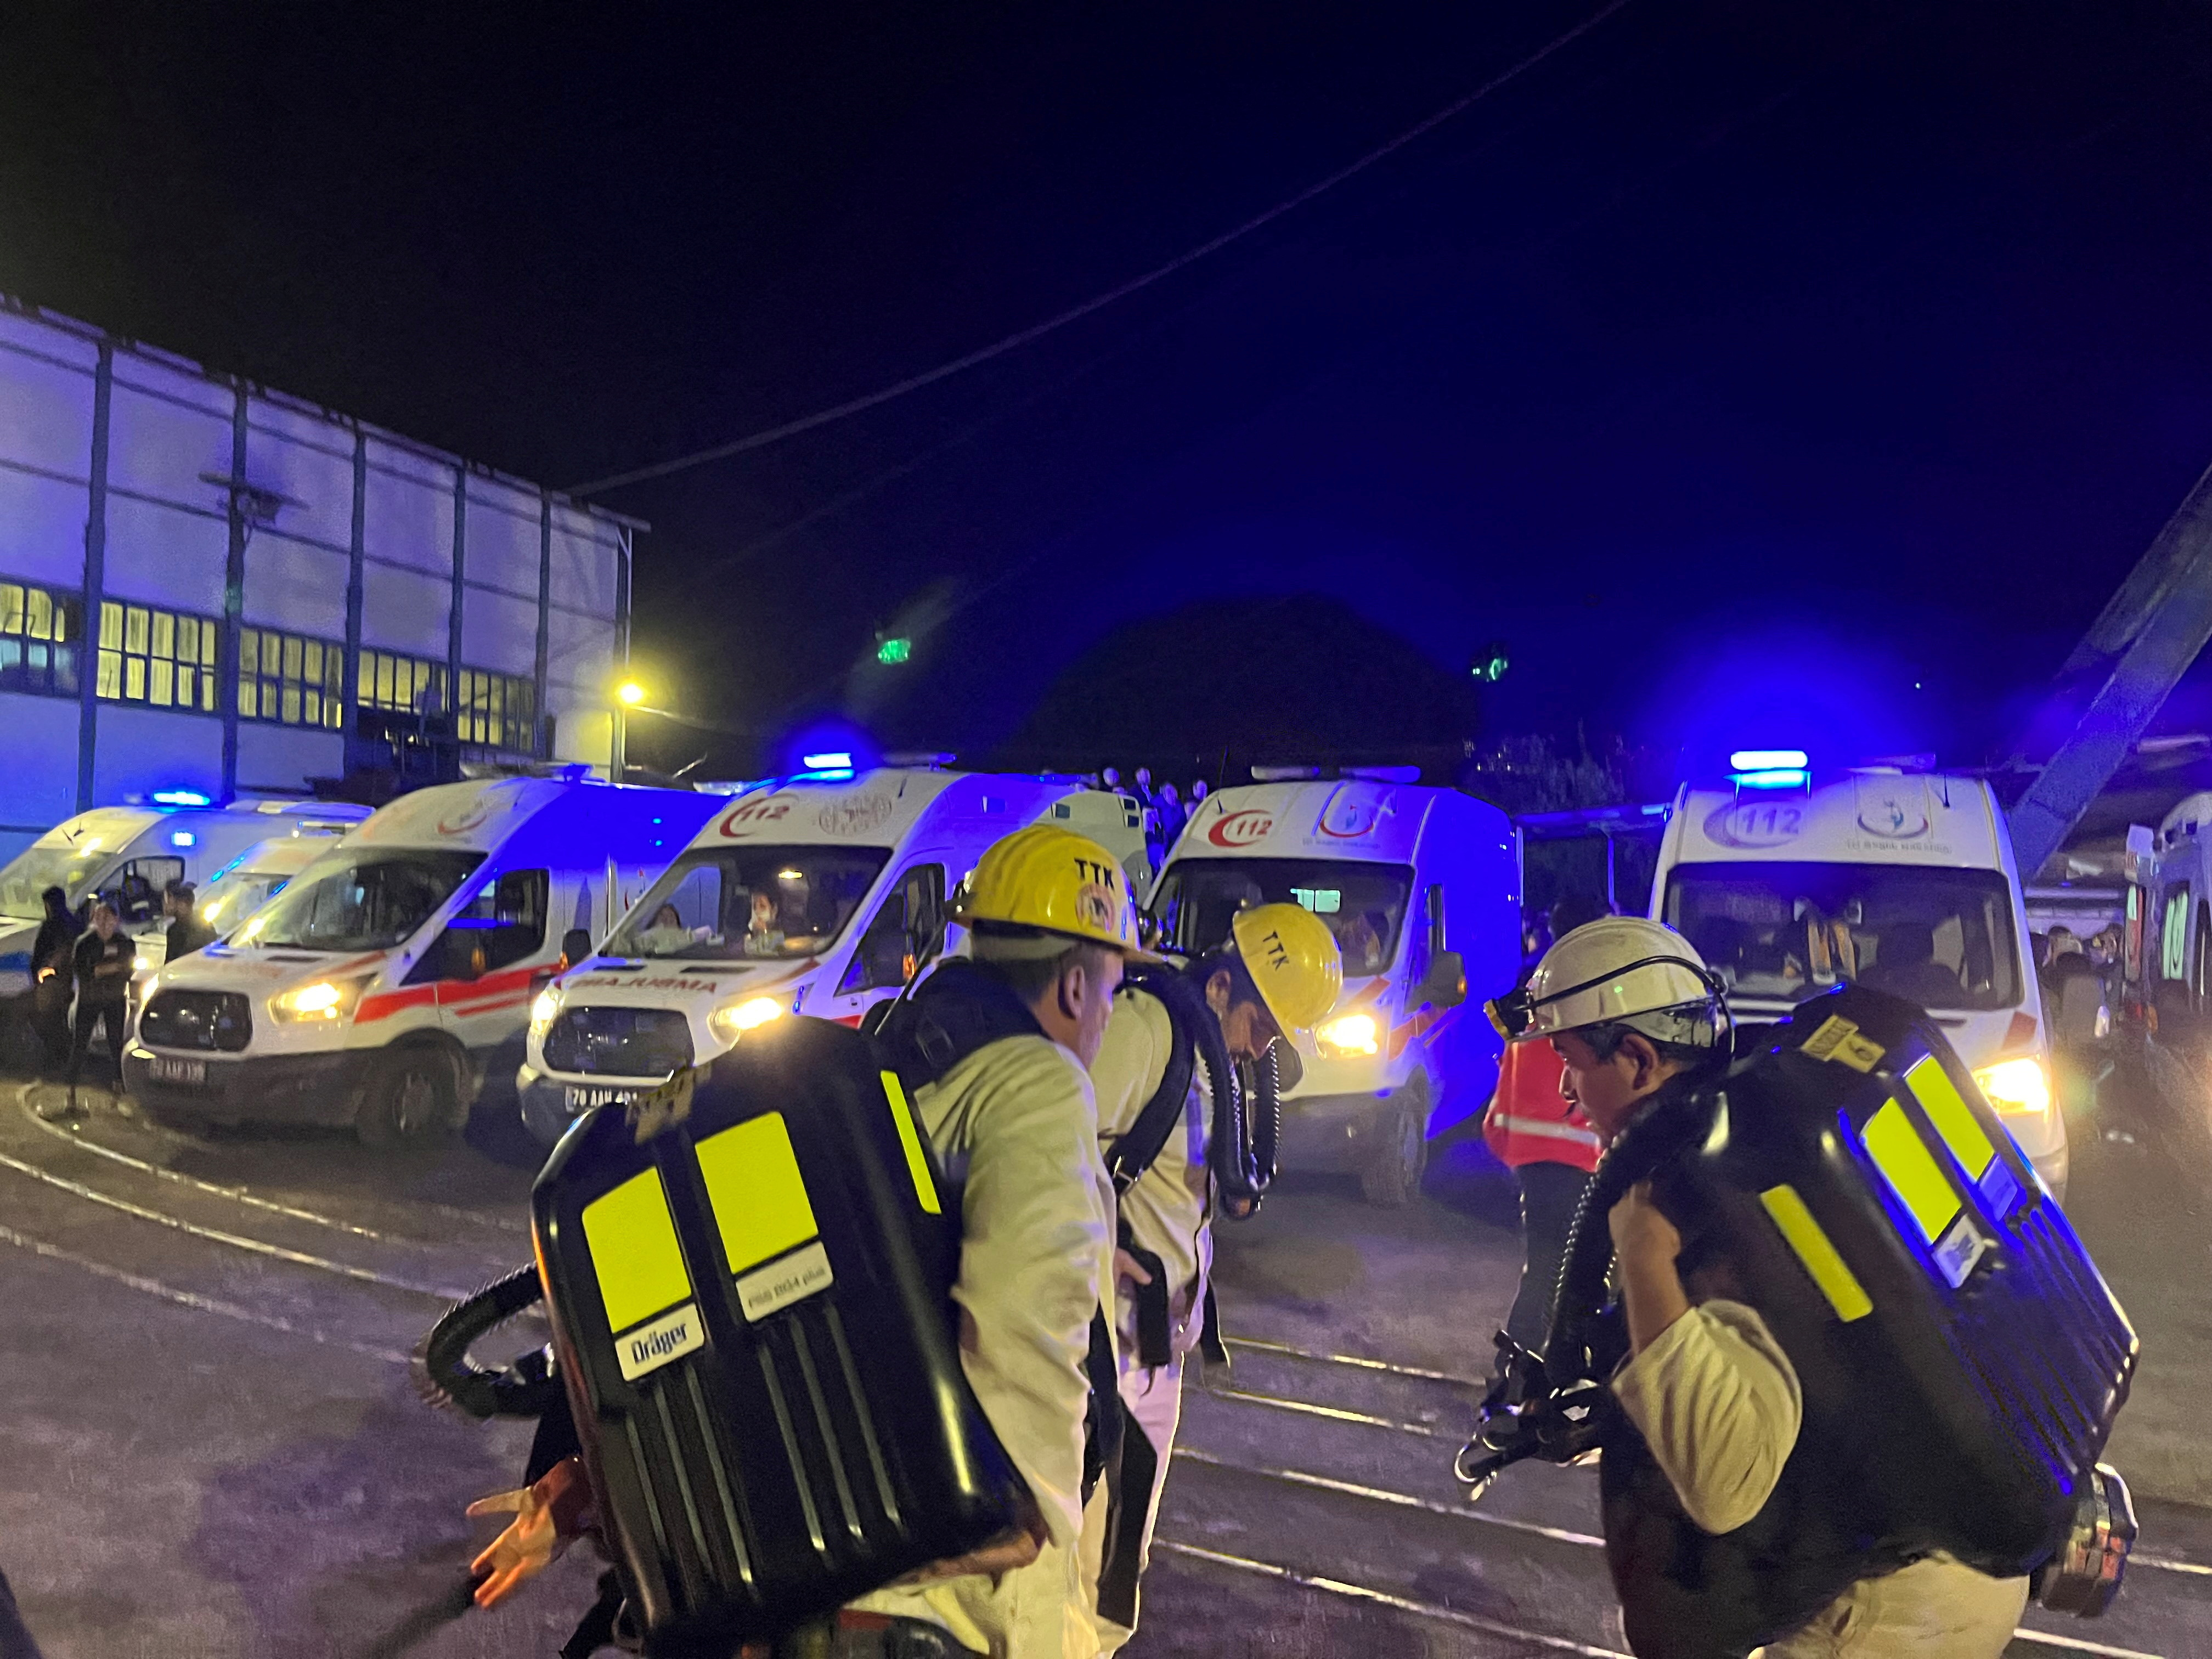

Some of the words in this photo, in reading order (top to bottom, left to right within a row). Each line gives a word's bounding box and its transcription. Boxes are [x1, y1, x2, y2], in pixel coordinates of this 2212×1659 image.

[1237, 819, 1273, 836] 112
[1741, 808, 1802, 834] 112
[1074, 856, 1115, 893] TTK
[1262, 929, 1289, 972] TTK
[631, 1323, 687, 1365] Dräger
